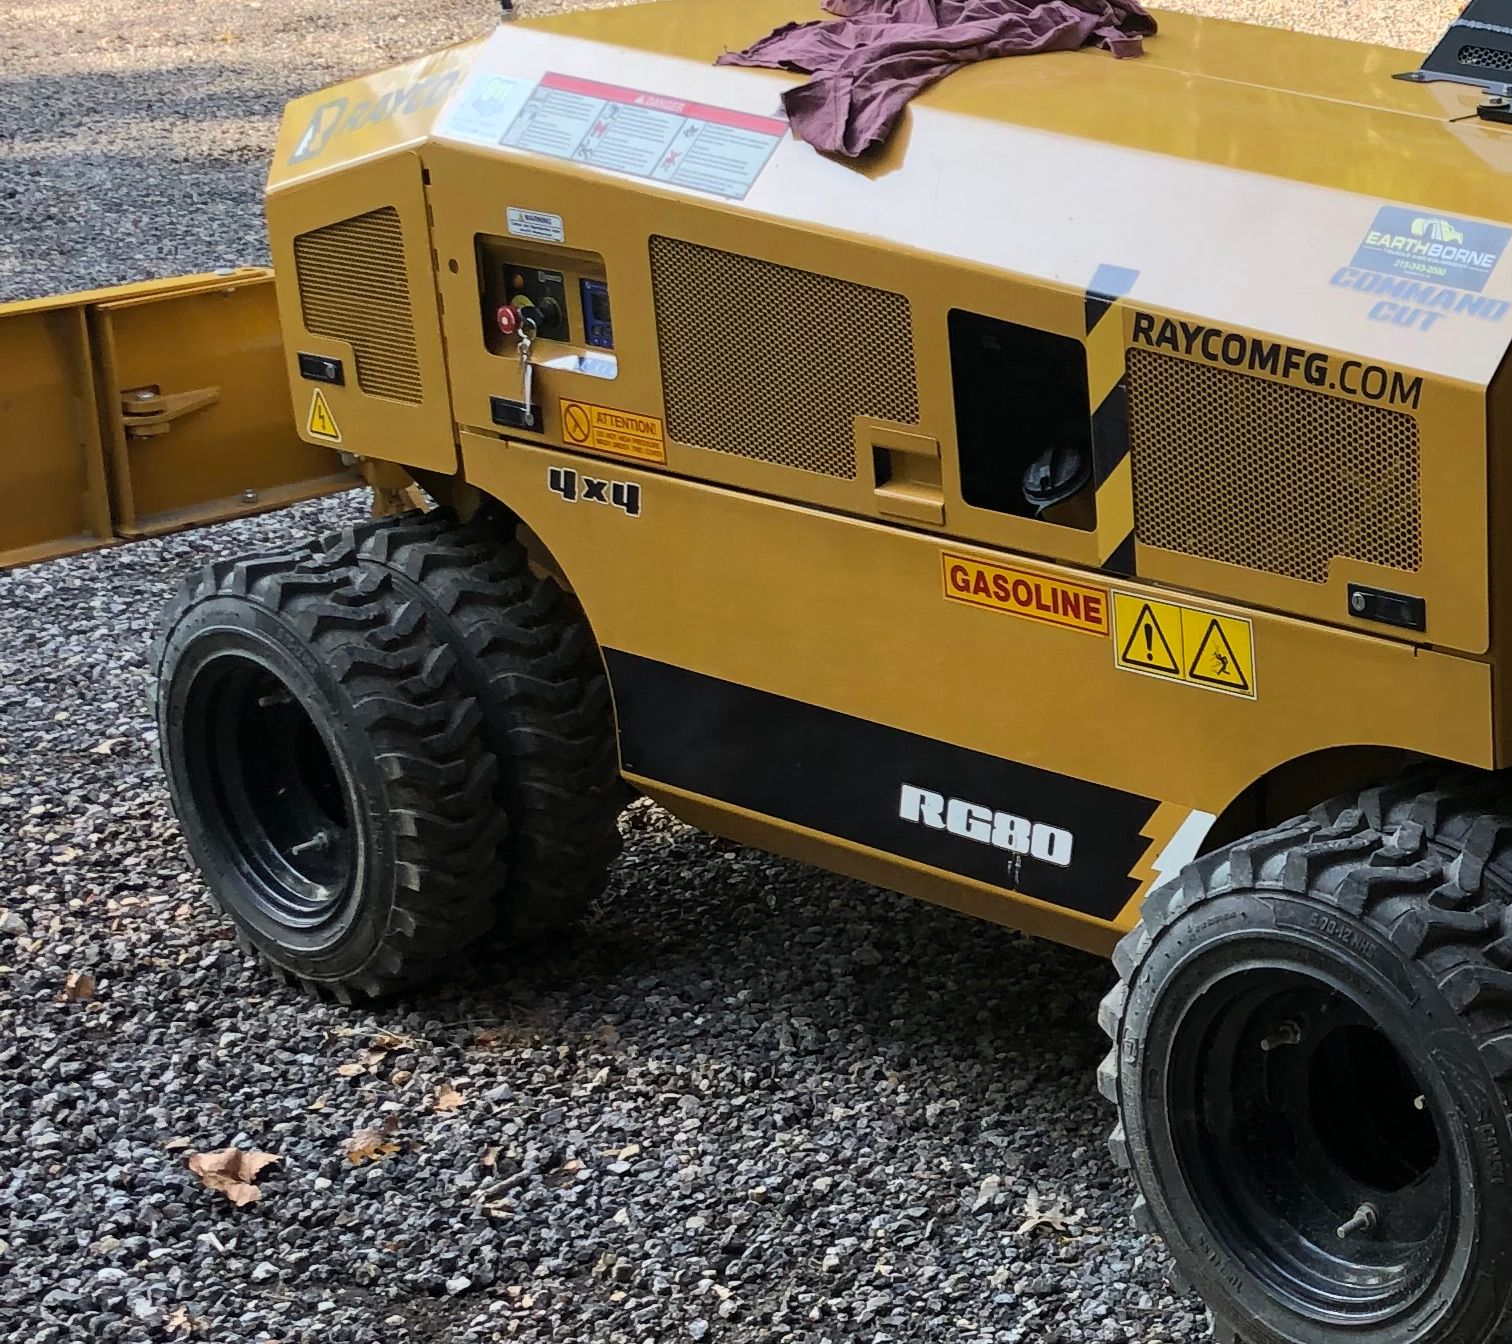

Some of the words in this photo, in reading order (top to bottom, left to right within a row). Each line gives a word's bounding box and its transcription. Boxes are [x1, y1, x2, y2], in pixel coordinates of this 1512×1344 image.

[1365, 230, 1496, 268] EARTHBORNE
[1328, 267, 1512, 324] COMMAND
[1367, 301, 1446, 333] CUT
[1131, 311, 1424, 410] RAYCOMFG.COM
[950, 564, 1103, 626] GASOLINE
[899, 782, 1074, 868] RG80
